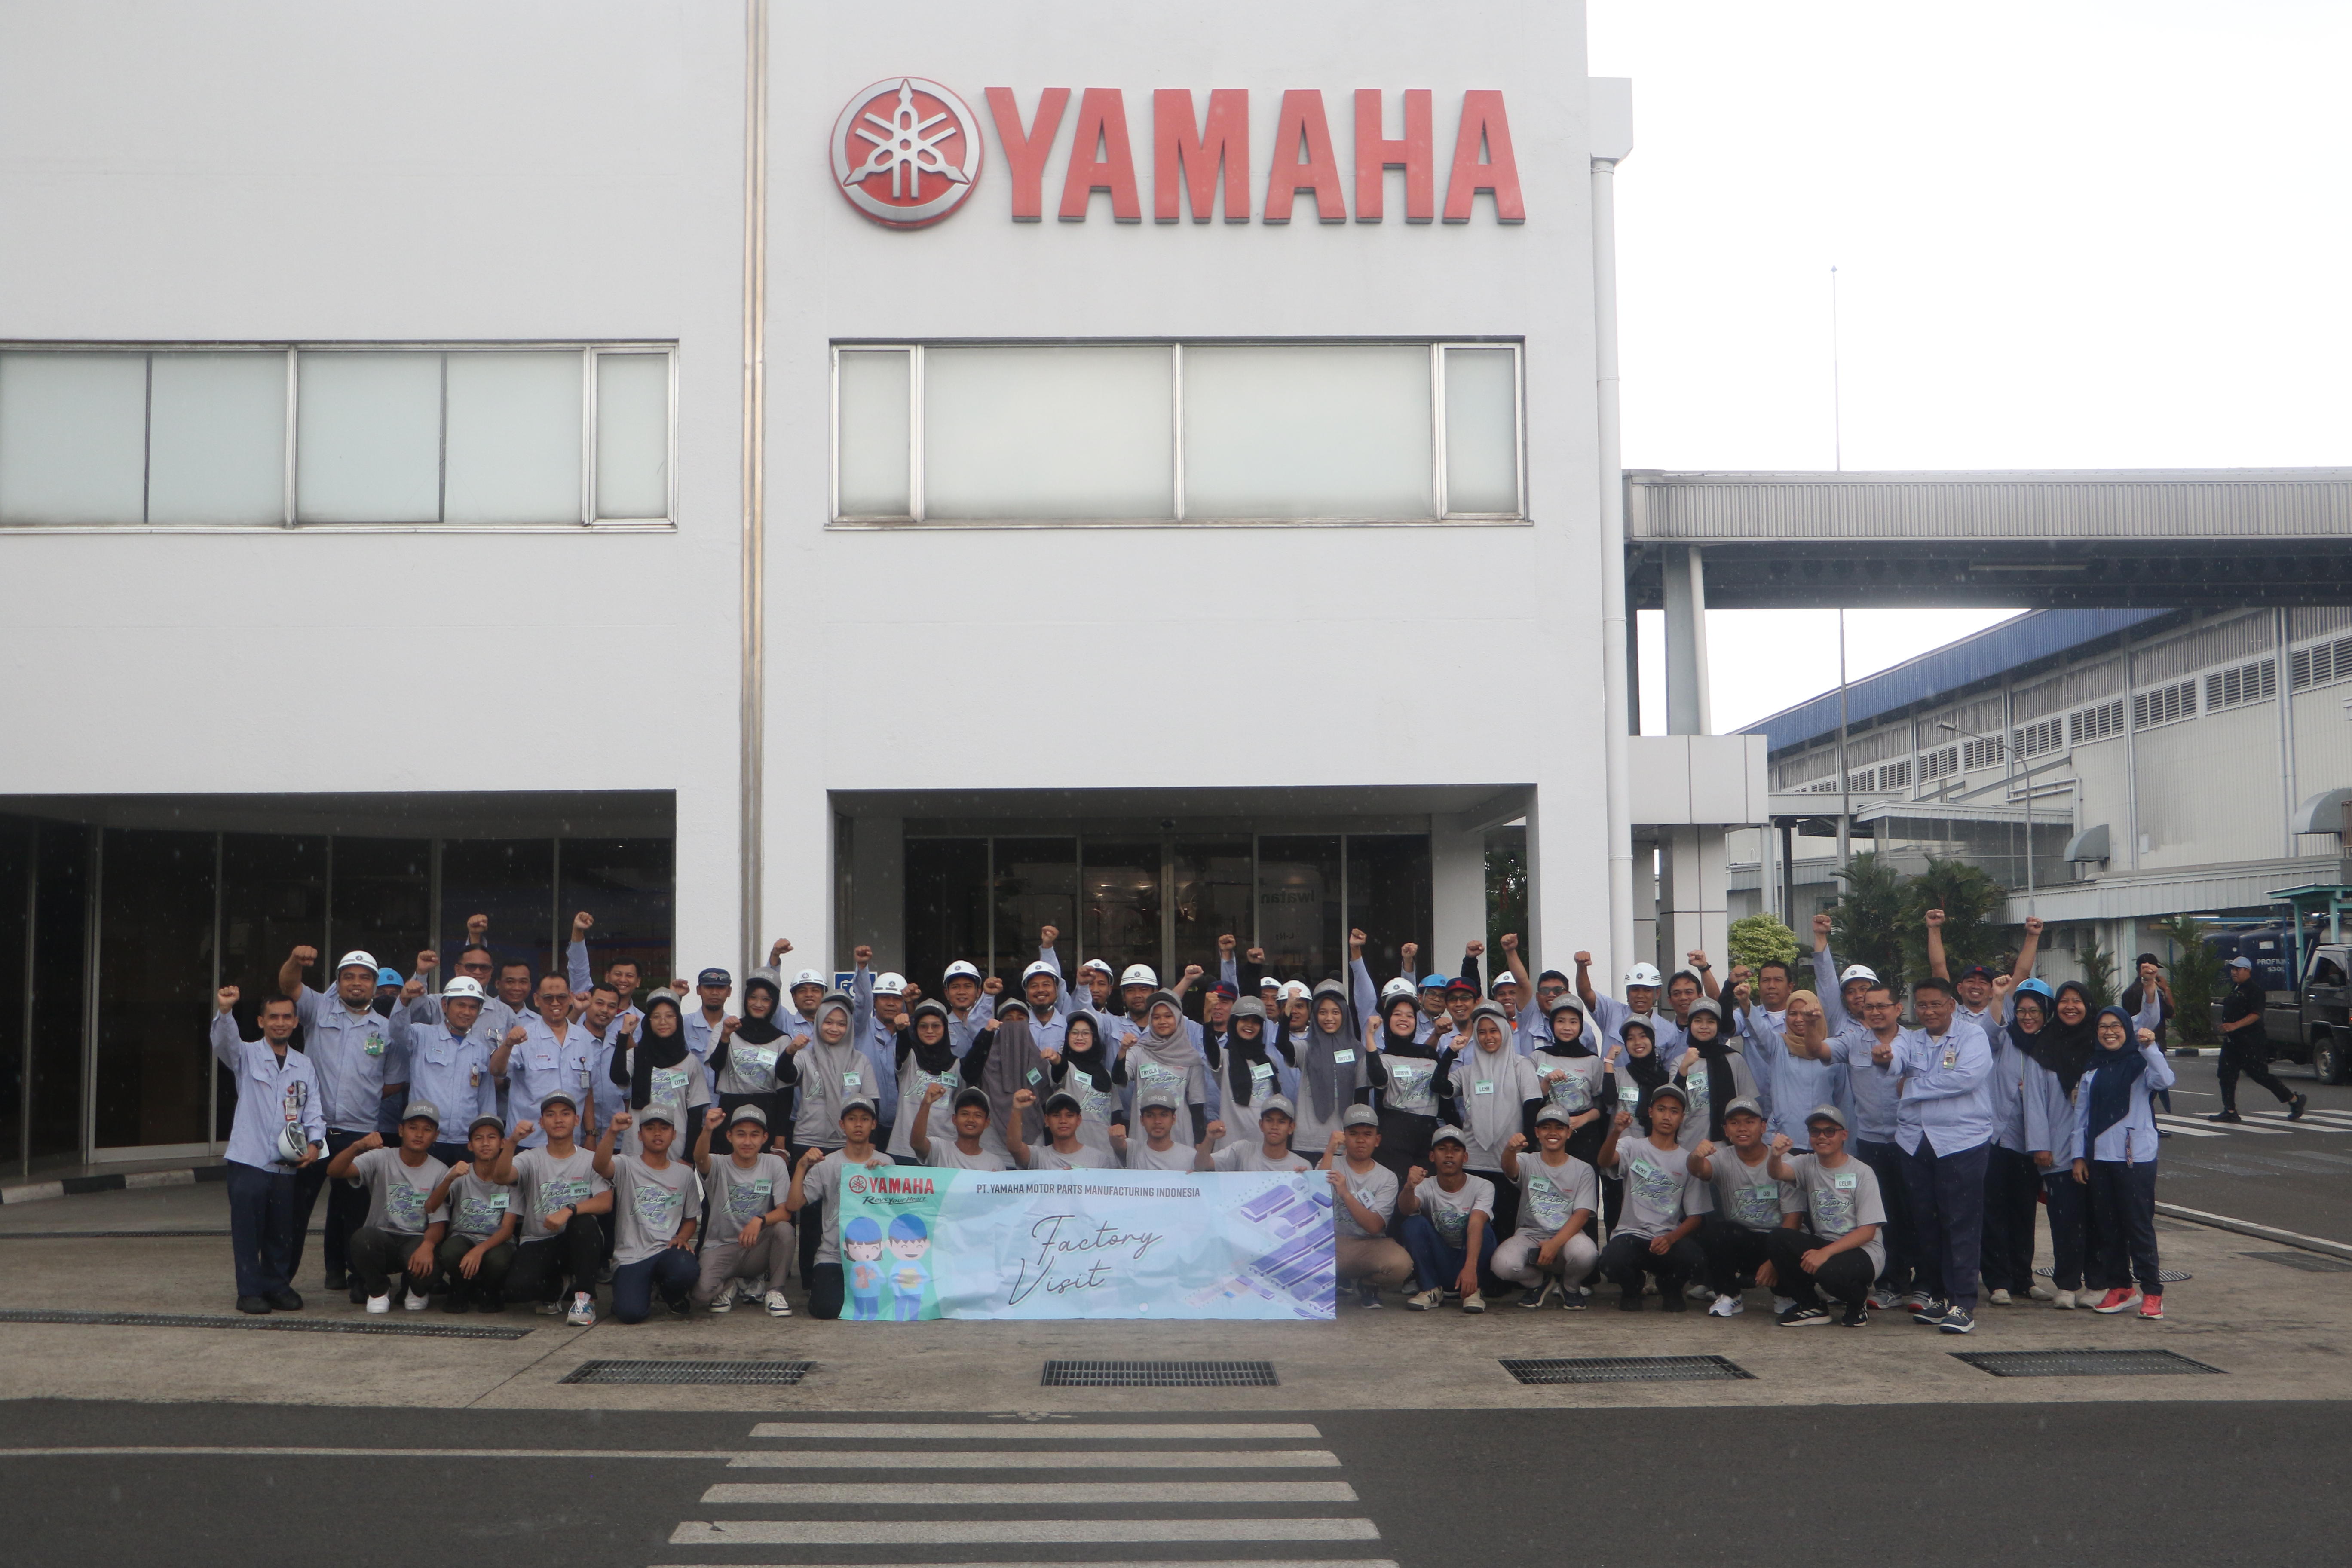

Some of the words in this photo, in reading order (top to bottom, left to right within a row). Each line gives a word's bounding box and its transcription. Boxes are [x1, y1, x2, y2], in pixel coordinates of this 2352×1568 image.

[984, 87, 1526, 224] YAMAHA
[904, 1080, 926, 1096] Vis
[1634, 1164, 1647, 1175] RIZKY
[539, 1182, 580, 1202] Facto
[869, 1177, 934, 1194] YAMAHA
[976, 1184, 989, 1194] PT.
[990, 1184, 1024, 1194] YAMAHA
[1026, 1184, 1054, 1194] MOTOR
[1057, 1185, 1082, 1194] PARTS
[1084, 1185, 1154, 1197] MANUFACTURING
[1156, 1188, 1200, 1197] INDONESIA
[634, 1186, 666, 1203] Facto
[1432, 1210, 1460, 1226] Fact
[1032, 1215, 1163, 1265] Factory
[1008, 1255, 1111, 1305] Visit
